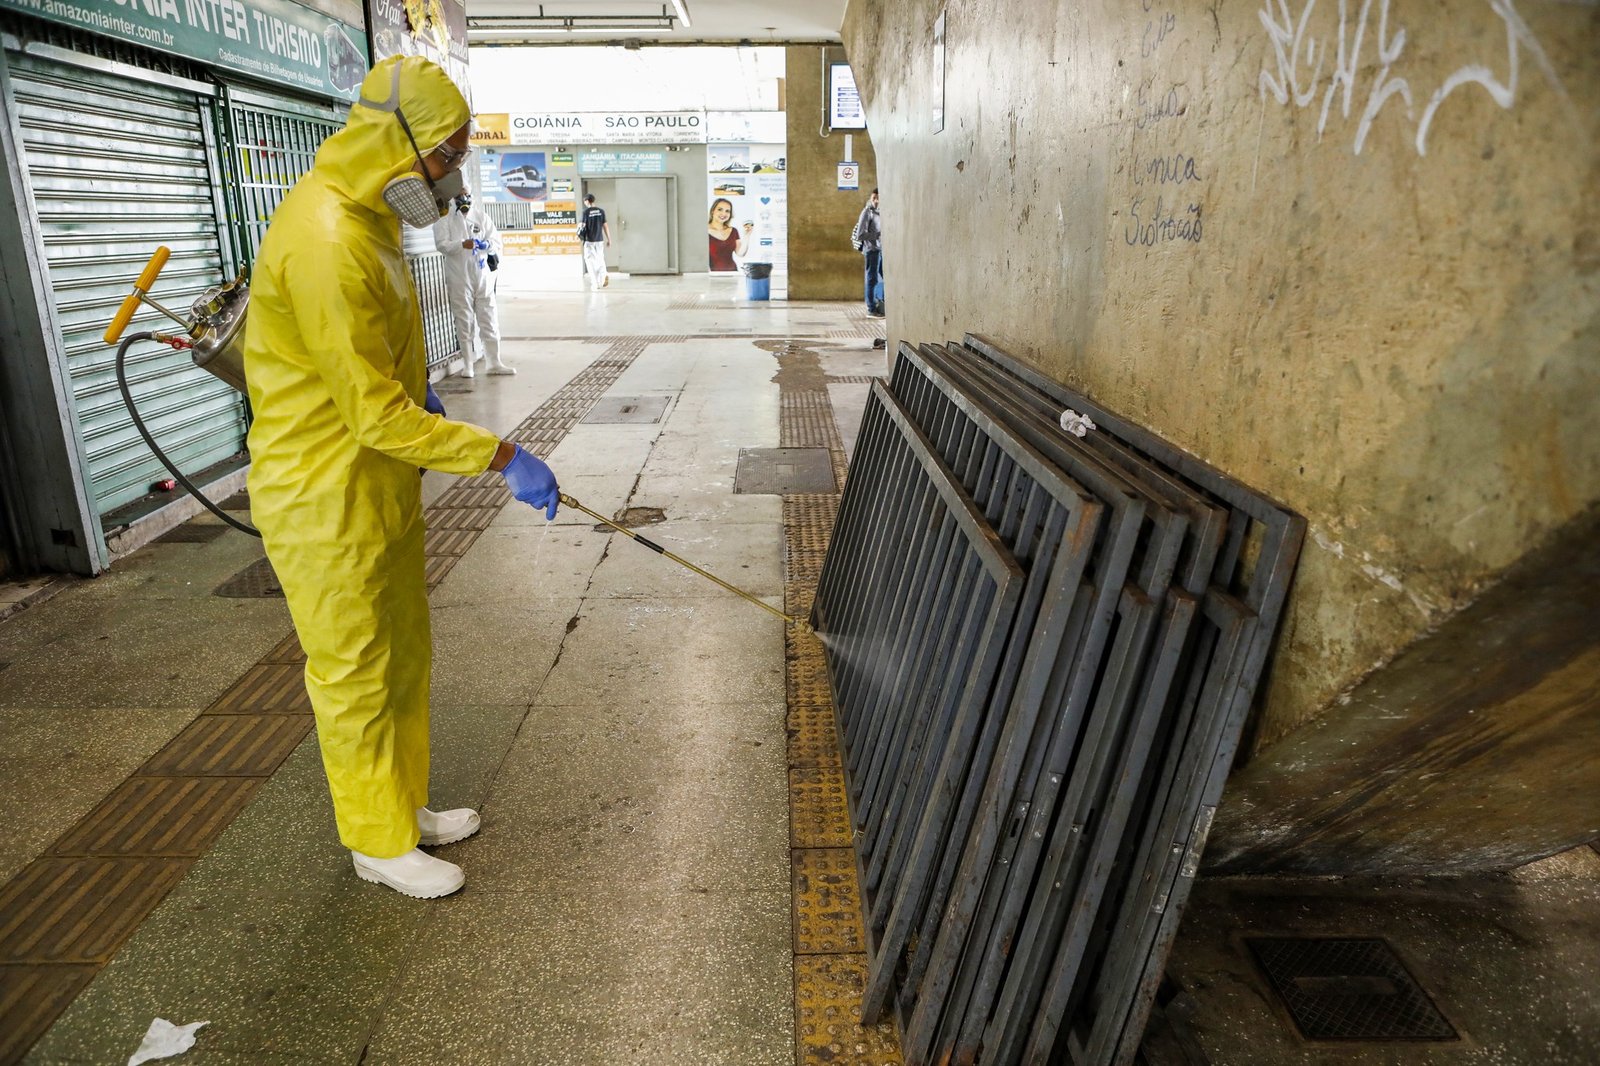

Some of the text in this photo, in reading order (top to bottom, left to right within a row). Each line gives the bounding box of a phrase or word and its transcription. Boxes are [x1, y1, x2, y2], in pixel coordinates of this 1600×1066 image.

[185, 0, 250, 44] INTER
[253, 10, 321, 69] TURISMO
[218, 47, 262, 71] Cadastramento
[262, 61, 270, 72] de
[513, 114, 700, 128] GOIÂNIA SÃO PAULO
[540, 234, 555, 243] SÃO
